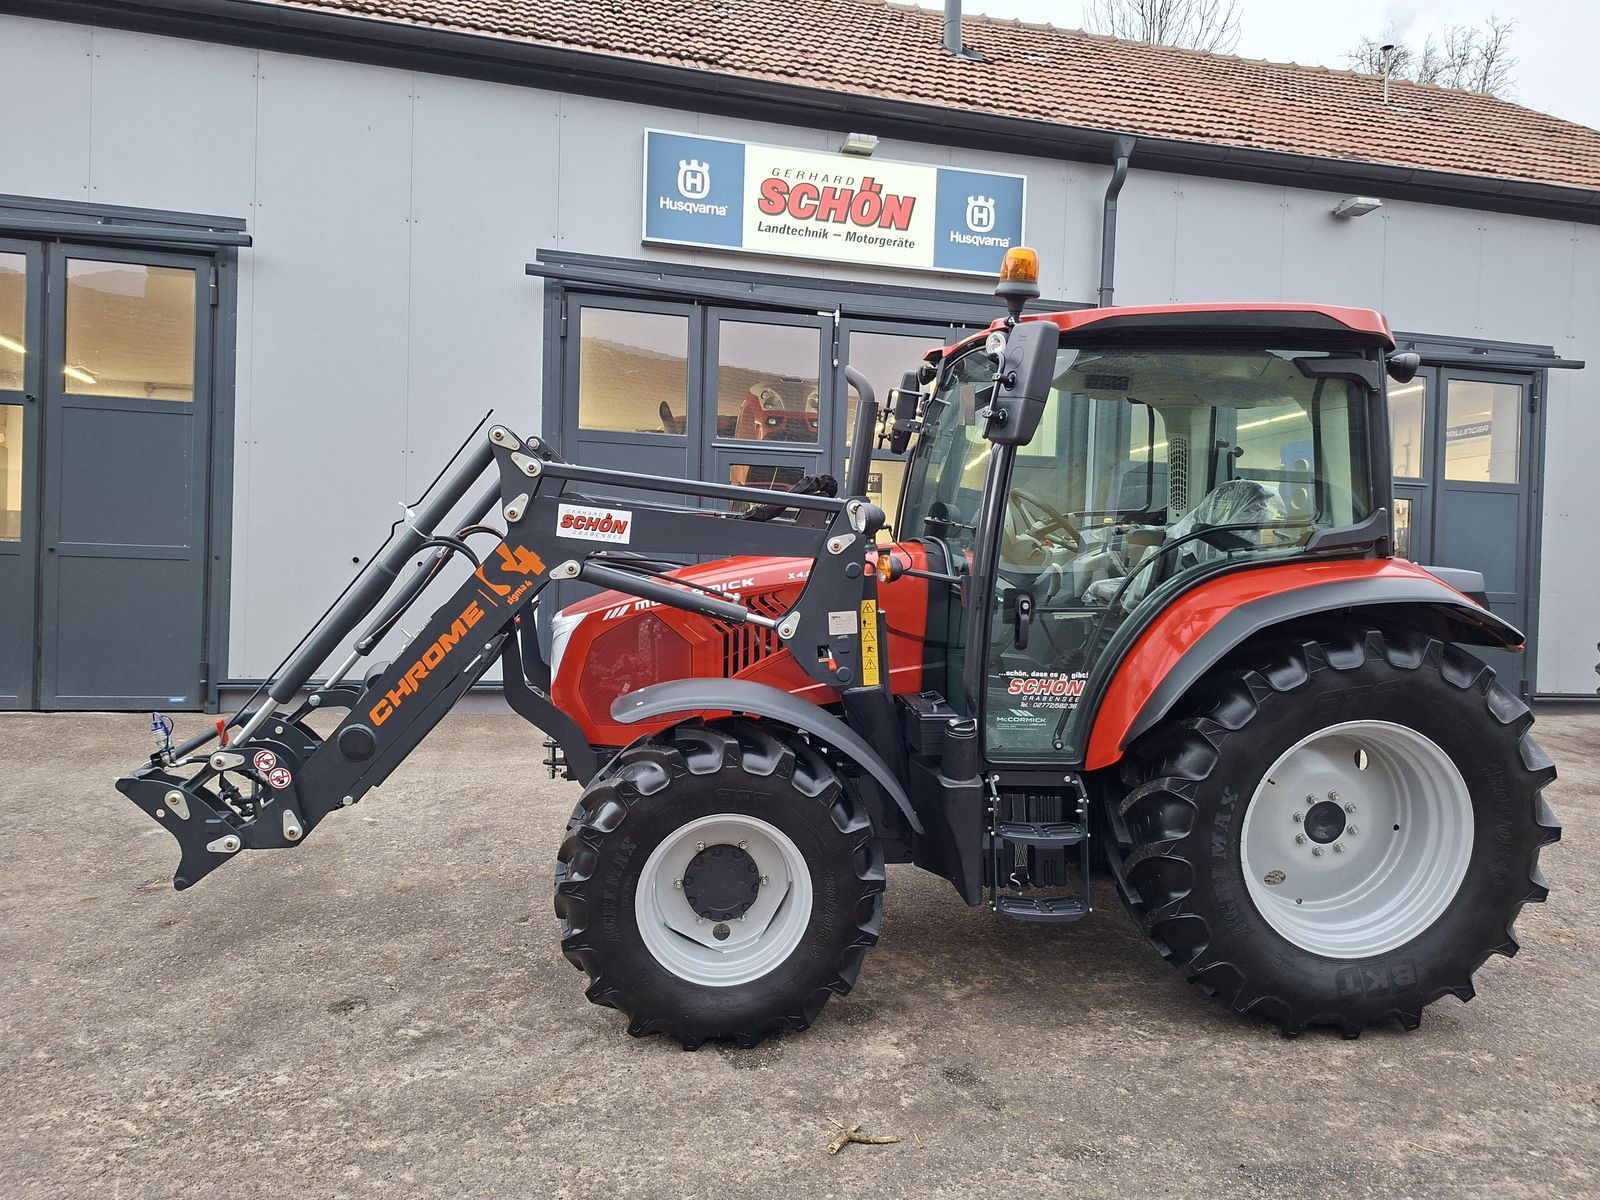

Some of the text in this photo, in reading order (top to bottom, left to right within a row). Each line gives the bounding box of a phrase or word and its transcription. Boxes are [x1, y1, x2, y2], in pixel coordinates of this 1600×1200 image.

[771, 167, 855, 186] GERHARD
[758, 177, 916, 231] SCHÖN
[757, 221, 829, 240] Landtechnik
[845, 231, 916, 249] Motorgeräte
[560, 512, 629, 535] SCHÖN
[506, 583, 528, 606] sigma
[369, 600, 486, 727] CHROME
[1008, 674, 1086, 696] SCHÖN
[1022, 695, 1080, 703] GRABENSEE
[996, 716, 1047, 724] McCORMICK
